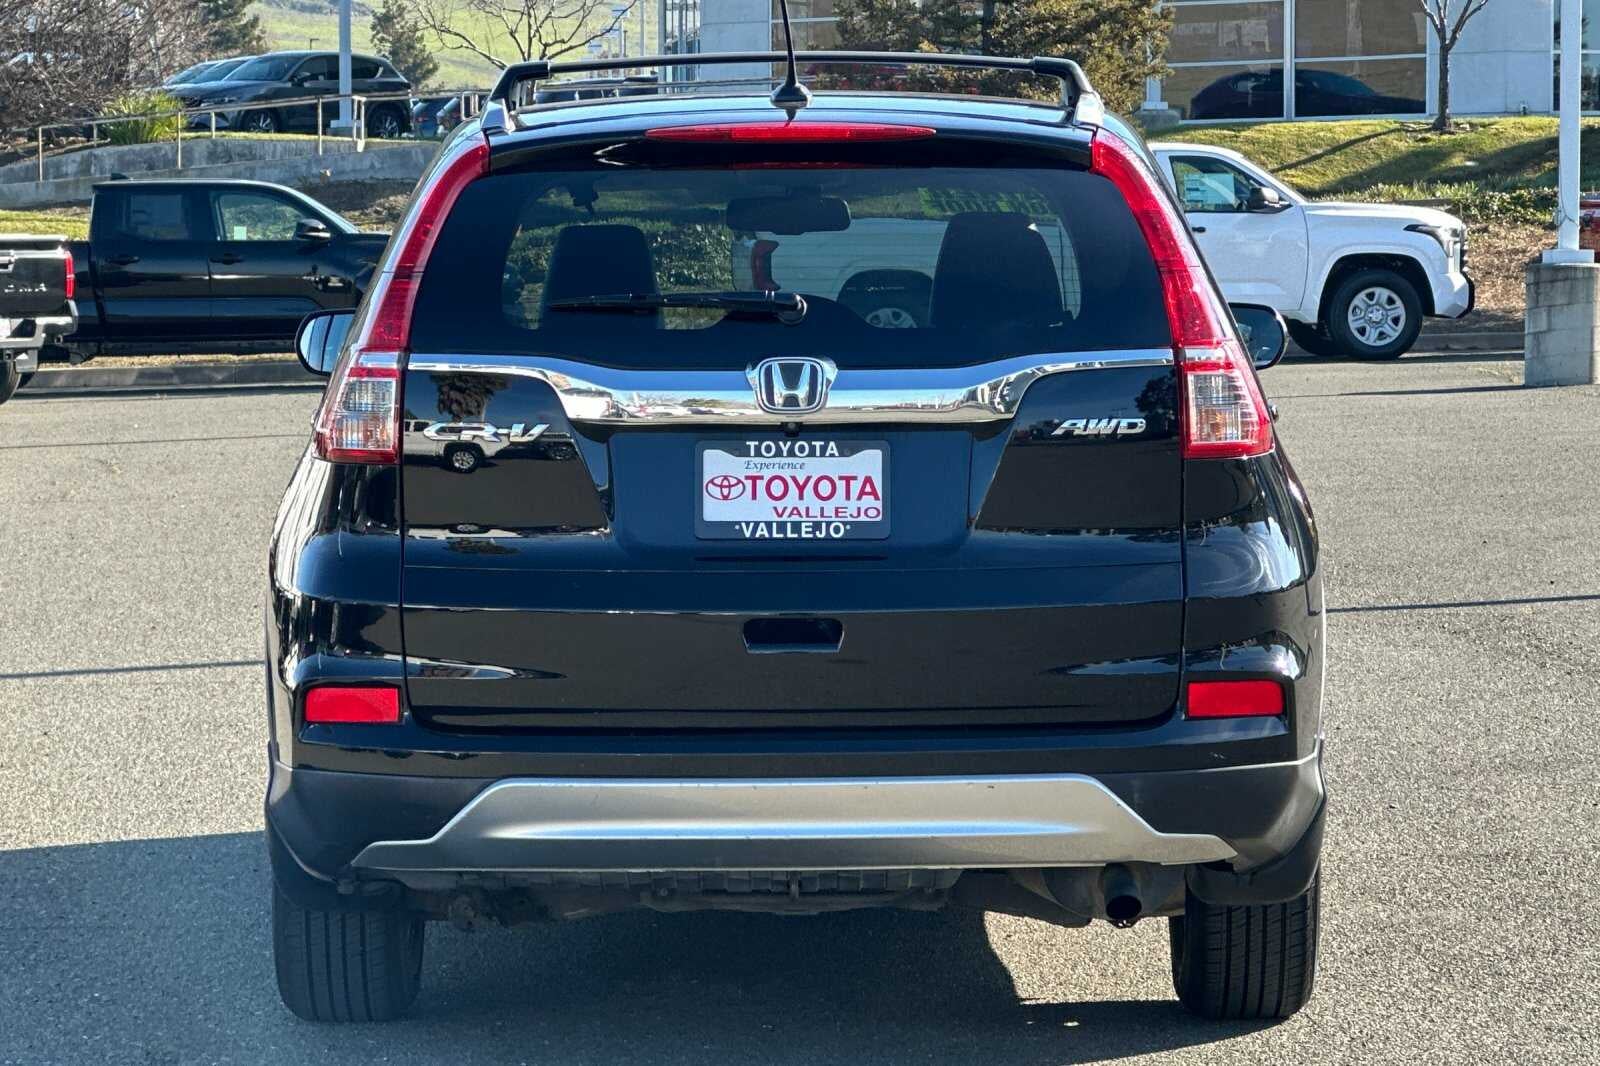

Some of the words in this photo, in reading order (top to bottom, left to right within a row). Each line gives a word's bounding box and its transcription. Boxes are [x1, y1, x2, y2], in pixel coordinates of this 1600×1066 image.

[423, 422, 550, 442] CR-V
[1051, 418, 1147, 436] AWD
[745, 441, 840, 457] TOYOTA
[744, 459, 806, 472] Experience
[744, 474, 881, 502] TOYOTA
[772, 506, 882, 519] VALLEJO
[740, 521, 846, 538] VALLEJO
